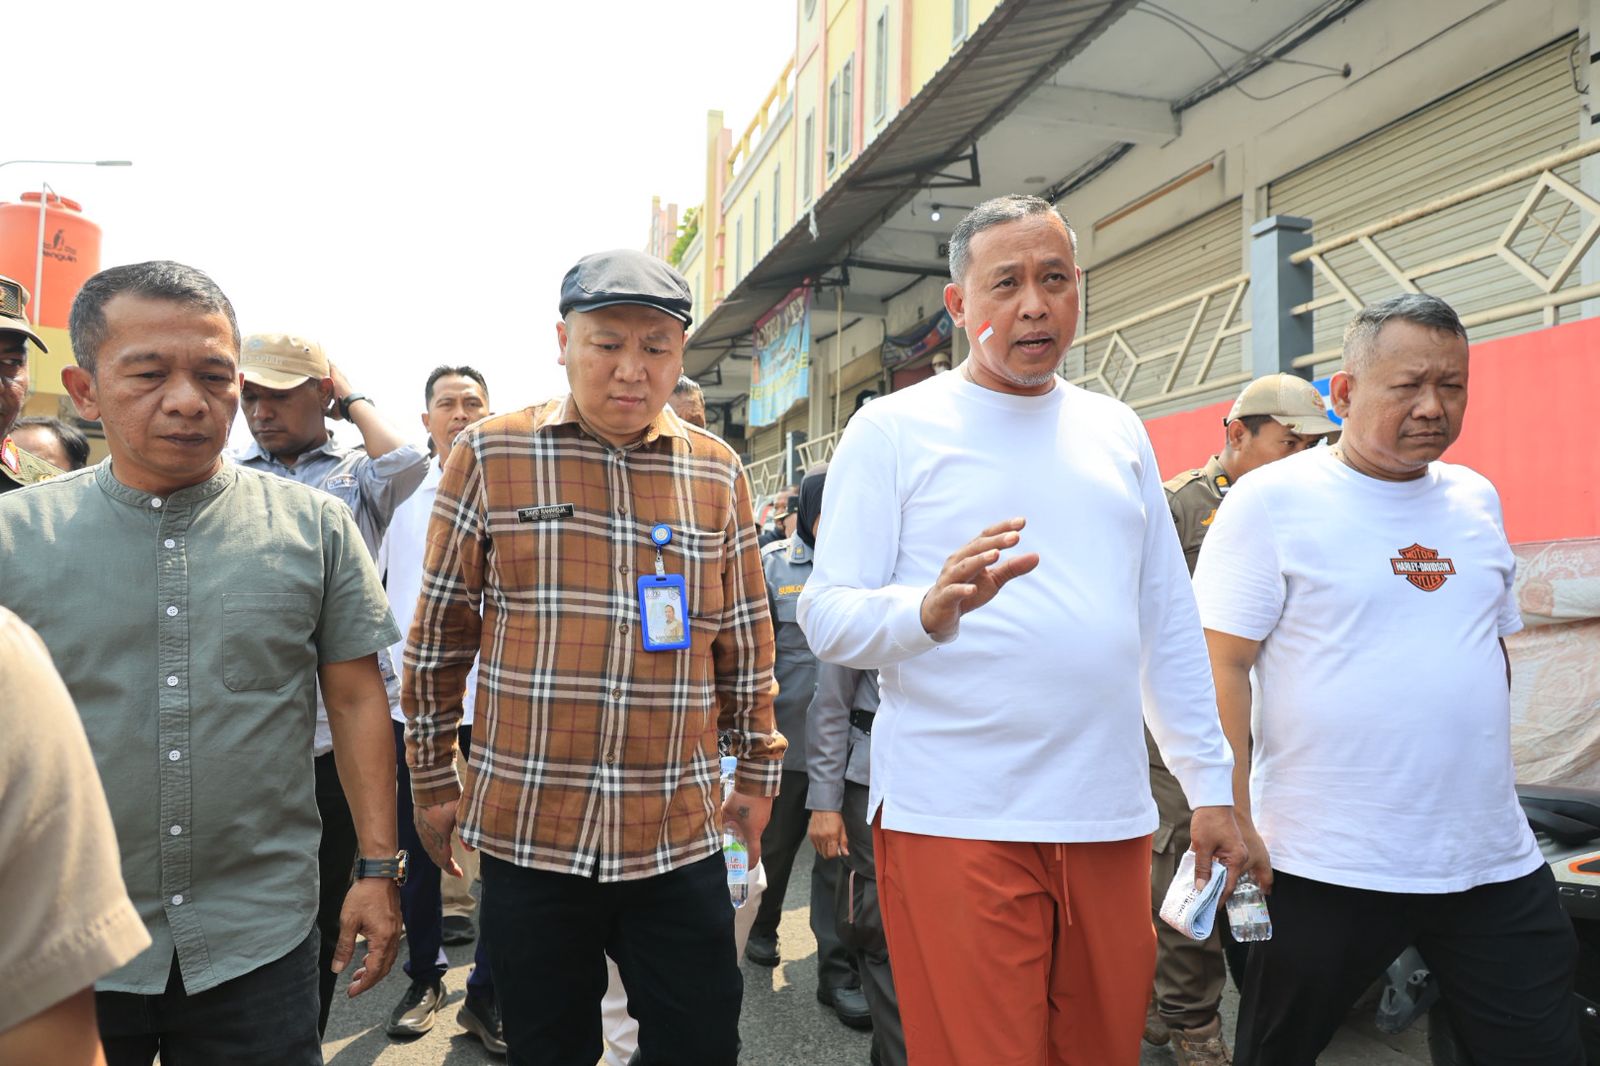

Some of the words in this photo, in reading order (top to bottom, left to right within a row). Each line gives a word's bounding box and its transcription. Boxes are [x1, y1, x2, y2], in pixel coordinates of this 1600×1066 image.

[43, 250, 77, 263] enguin
[1405, 549, 1434, 558] MOTOR
[1395, 561, 1451, 573] HARLEY-DAVIDSON
[1411, 575, 1442, 589] CYCLES
